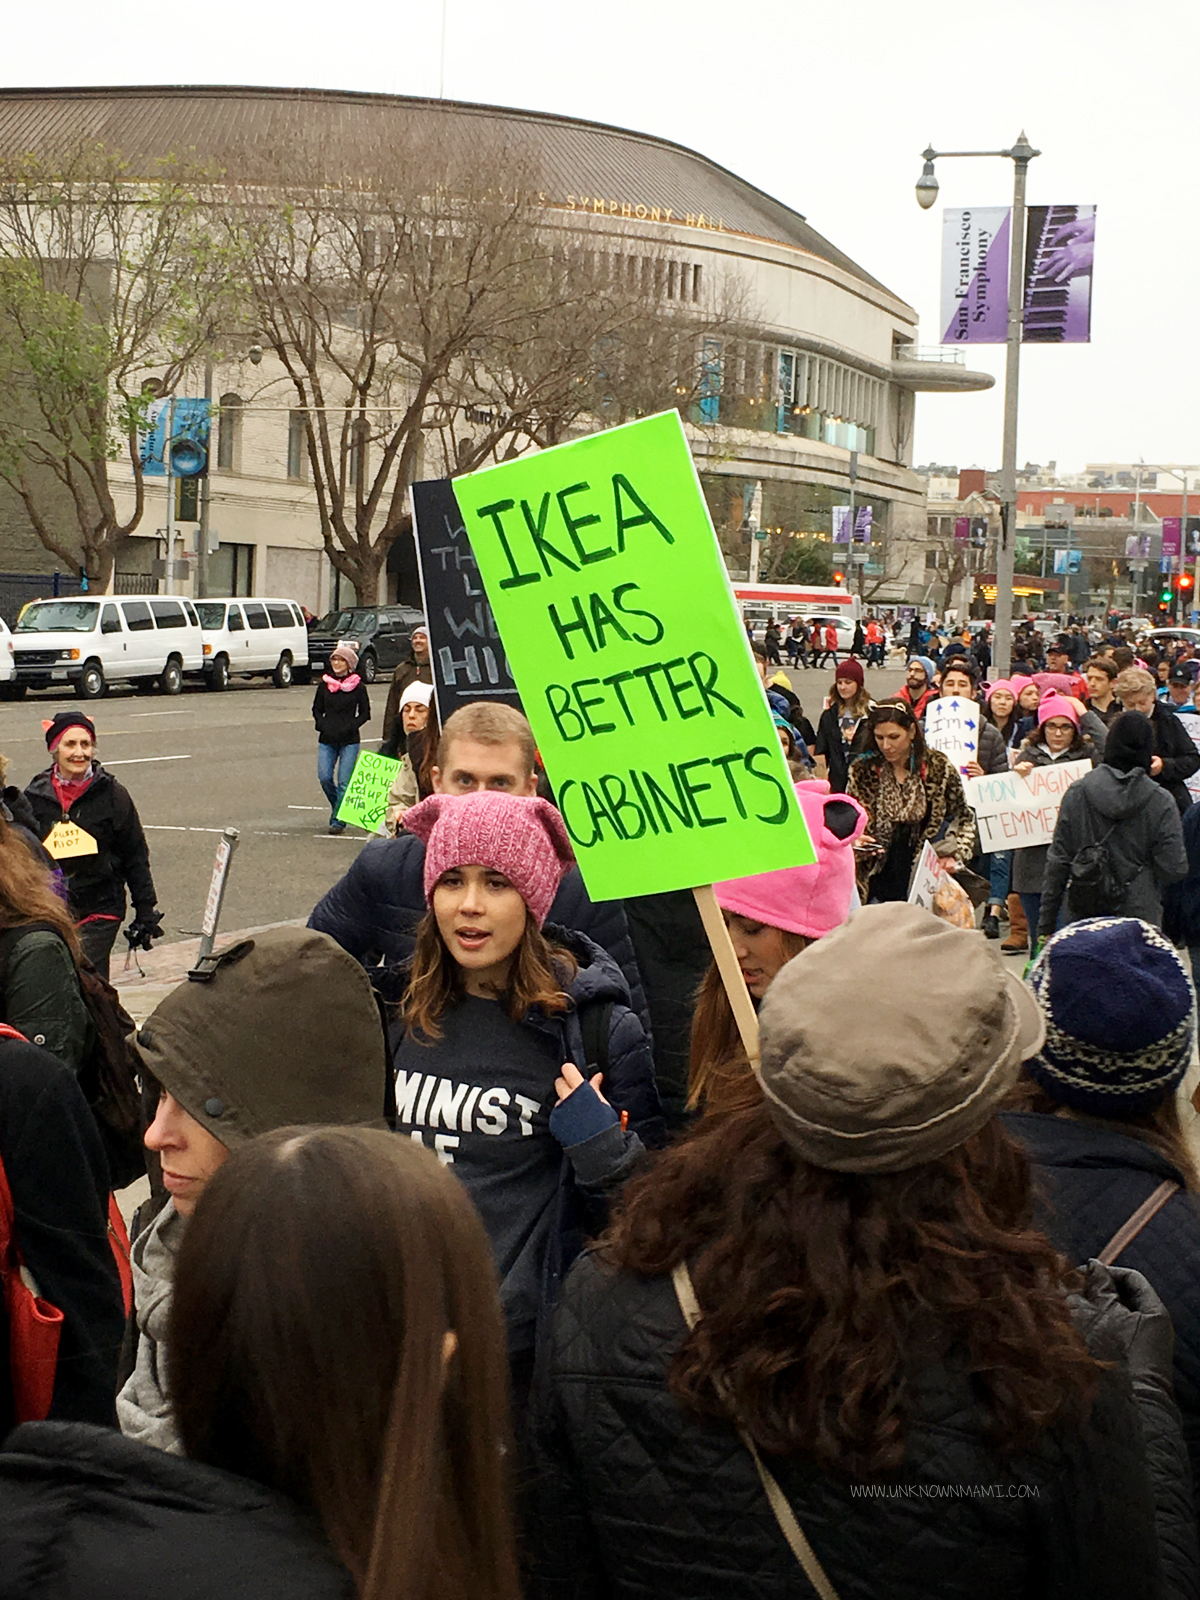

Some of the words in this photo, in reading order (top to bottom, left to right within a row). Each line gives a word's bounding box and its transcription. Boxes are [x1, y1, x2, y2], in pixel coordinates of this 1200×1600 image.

[566, 194, 673, 222] SYMPHONY
[686, 212, 726, 233] HALL
[955, 211, 972, 299] Francisco
[972, 228, 992, 323] Symphony
[954, 306, 969, 340] San
[476, 473, 675, 589] IKEA
[547, 582, 665, 660] HAS
[438, 645, 514, 686] HI
[544, 651, 745, 742] BETTER
[932, 717, 961, 733] I'm
[361, 754, 382, 770] SO
[978, 778, 1017, 803] MON
[558, 746, 790, 848] CABINETS
[394, 1069, 541, 1136] MINIST
